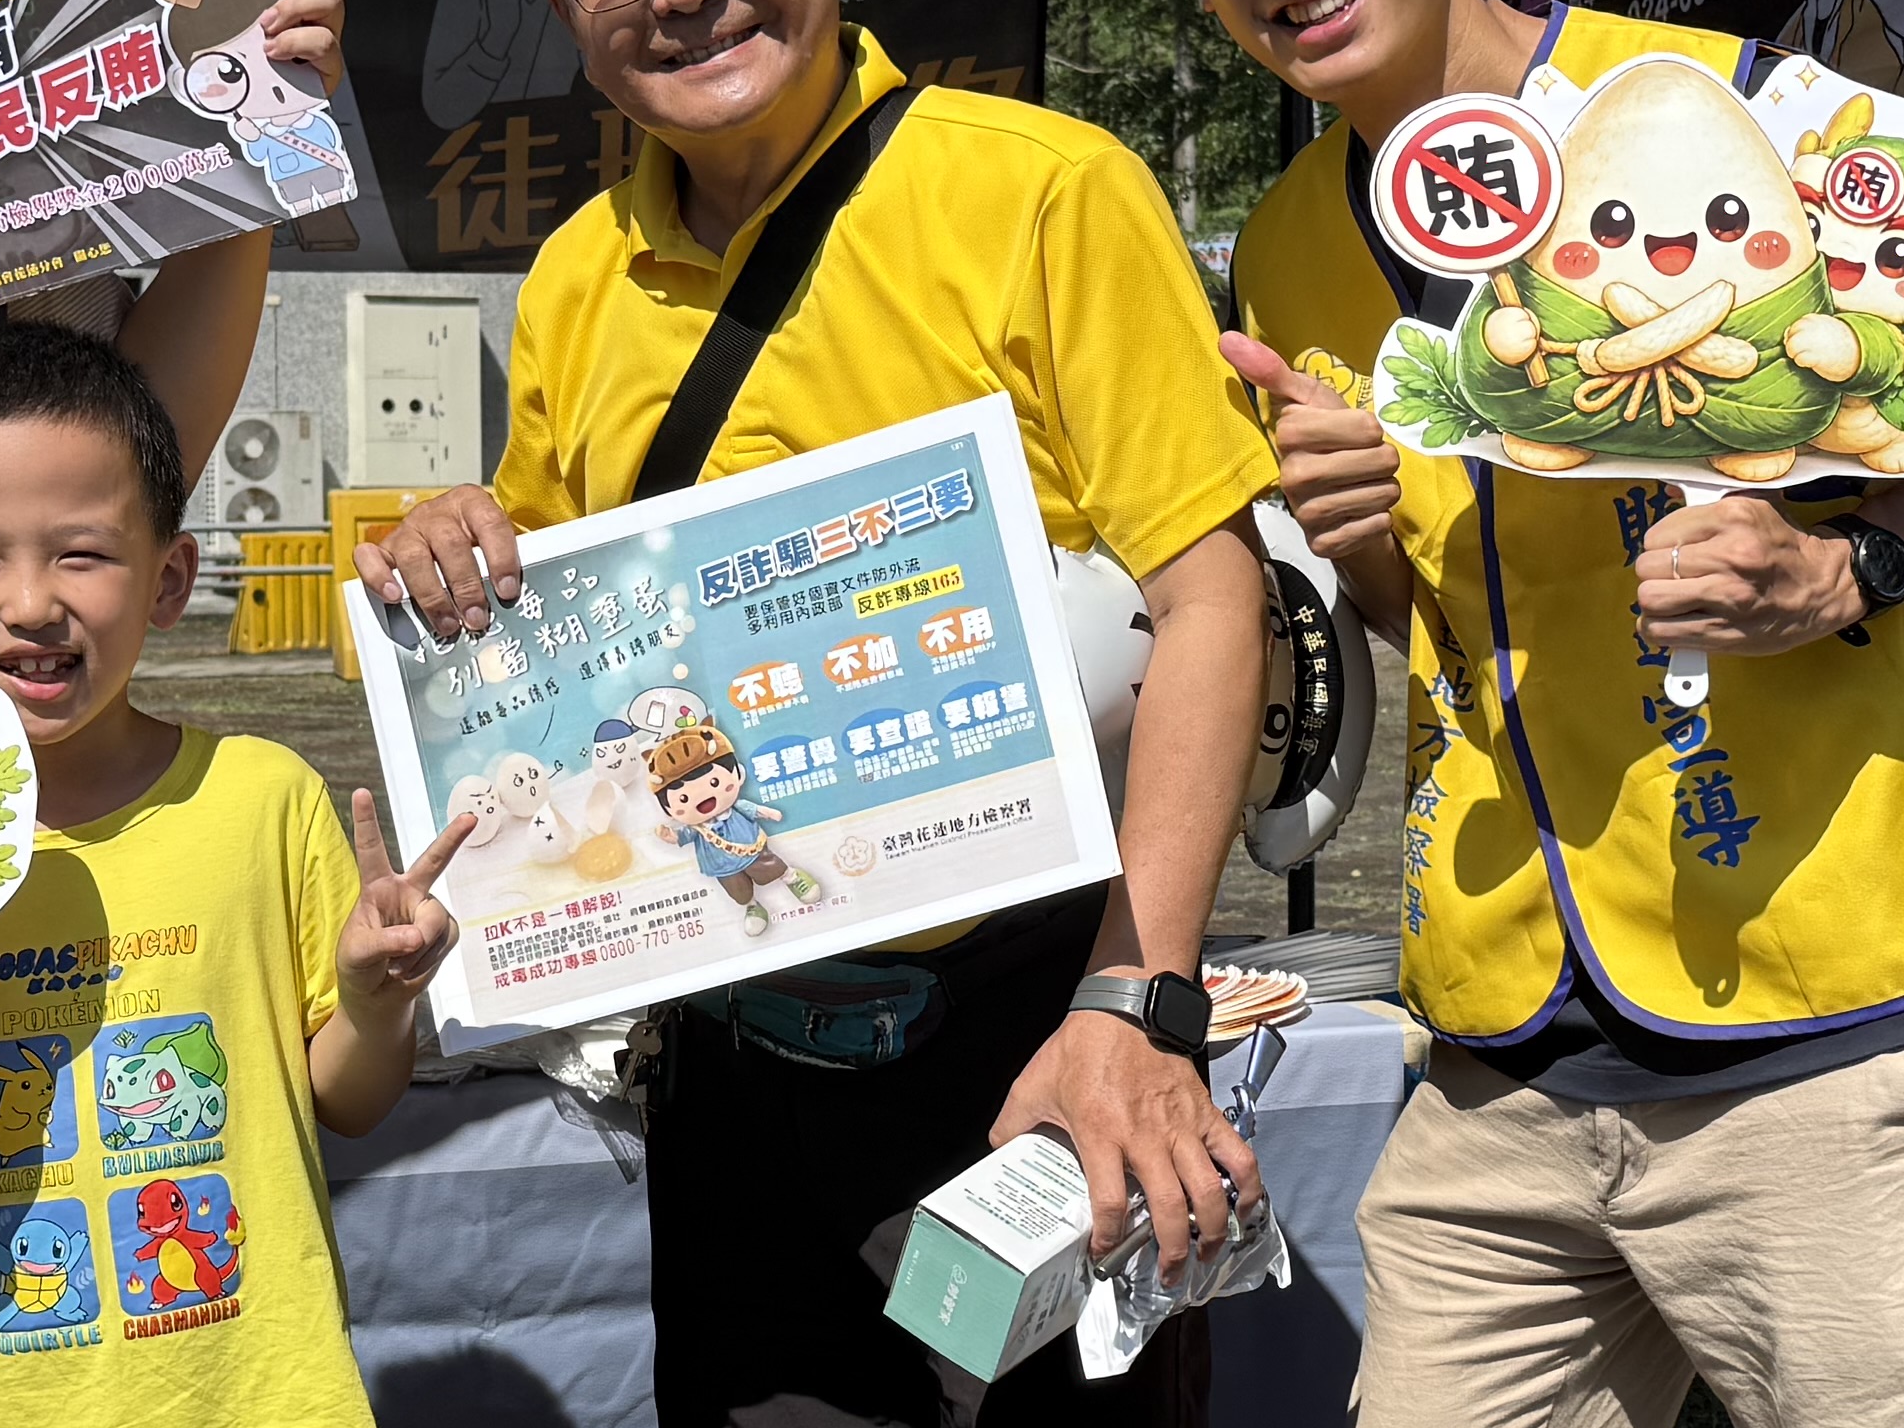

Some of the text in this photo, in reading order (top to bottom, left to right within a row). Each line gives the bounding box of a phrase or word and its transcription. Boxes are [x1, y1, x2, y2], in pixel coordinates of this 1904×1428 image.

[1419, 134, 1523, 237] 賄
[696, 468, 975, 608] 反詐騙三不三要
[747, 570, 962, 636] 多利用內政部 反詐專線165
[921, 606, 995, 654] 不用
[826, 635, 900, 682] 不加
[731, 661, 805, 709] 不聽
[599, 919, 705, 962] 0800-770-885
[1, 989, 161, 1036] POKÉMON
[102, 1141, 225, 1178] BULBASAUR
[123, 1298, 241, 1340] CHARMANDER
